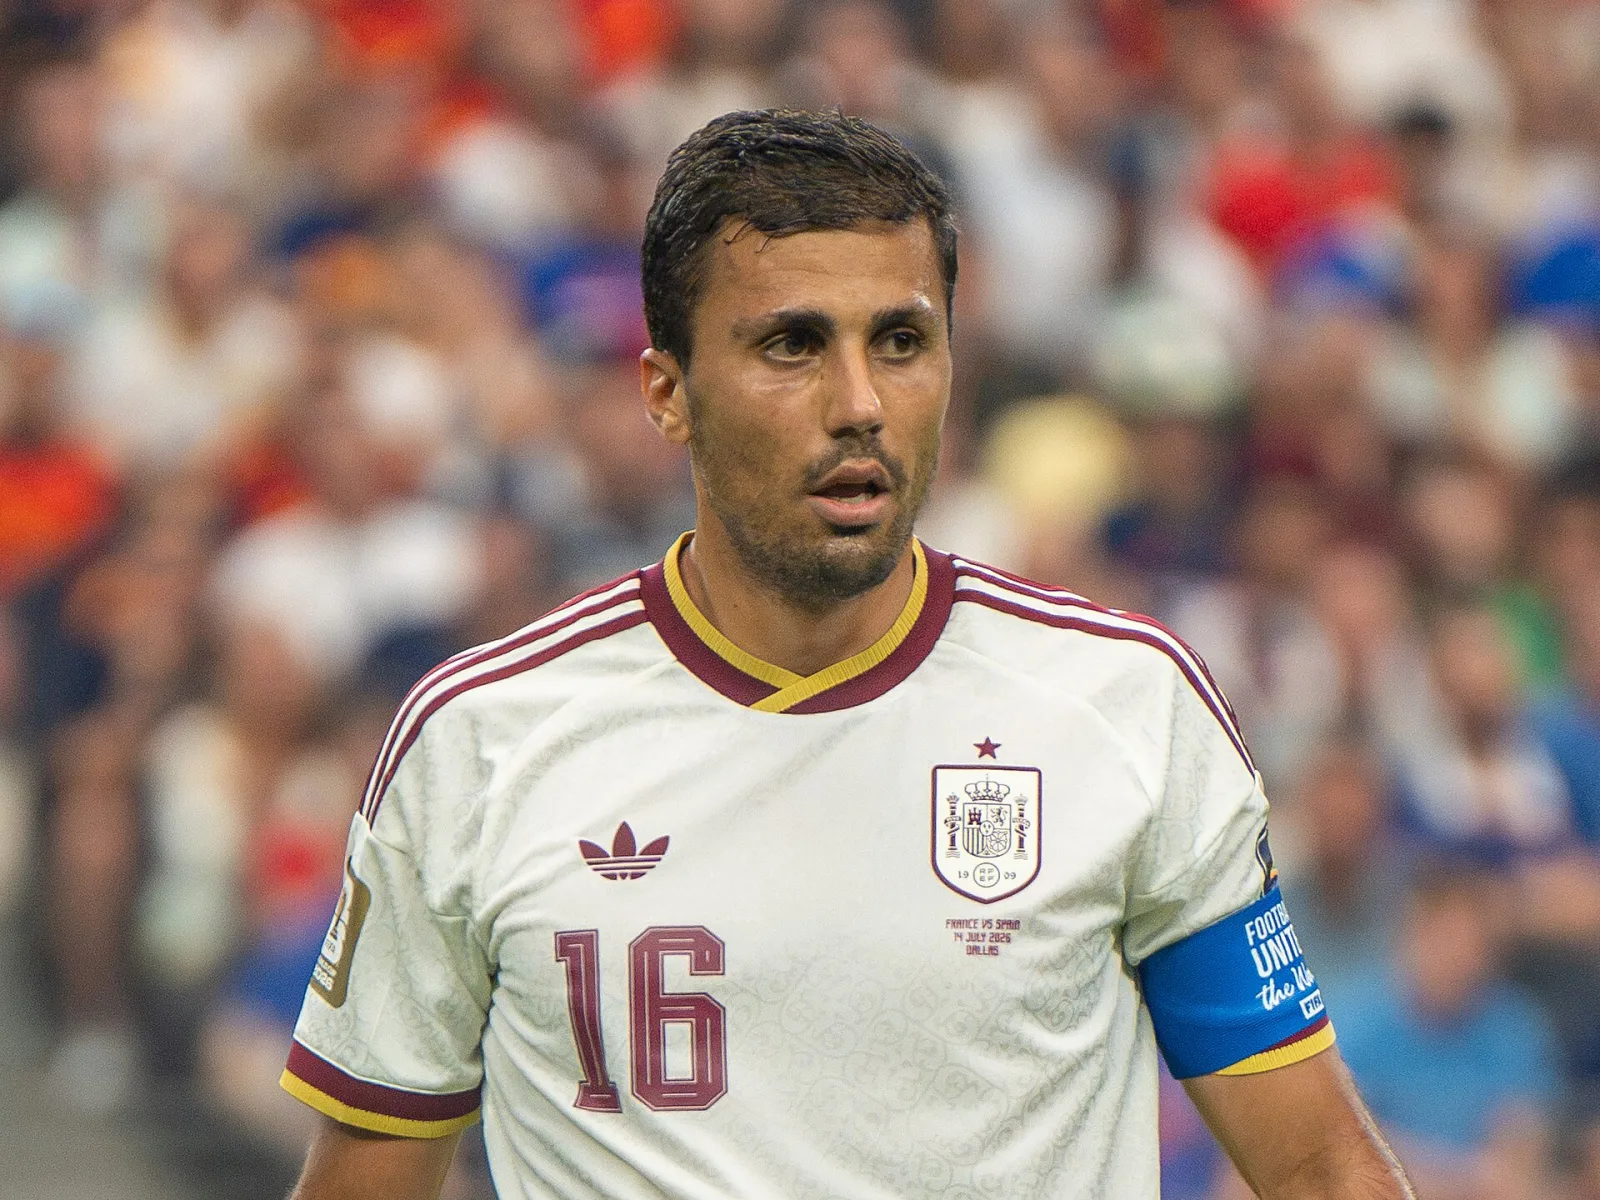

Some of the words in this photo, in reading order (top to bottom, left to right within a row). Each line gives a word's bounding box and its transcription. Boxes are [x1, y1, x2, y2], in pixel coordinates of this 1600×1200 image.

[958, 870, 969, 879] 19
[1003, 871, 1017, 880] 09
[945, 918, 979, 929] FRANCE
[981, 918, 993, 929] VS
[995, 918, 1021, 930] SPAIN
[953, 931, 963, 942] 14
[965, 931, 987, 942] JULY
[989, 932, 1011, 943] 2026
[966, 944, 999, 956] DALLAS
[1255, 977, 1295, 1011] the
[554, 925, 728, 1113] 16
